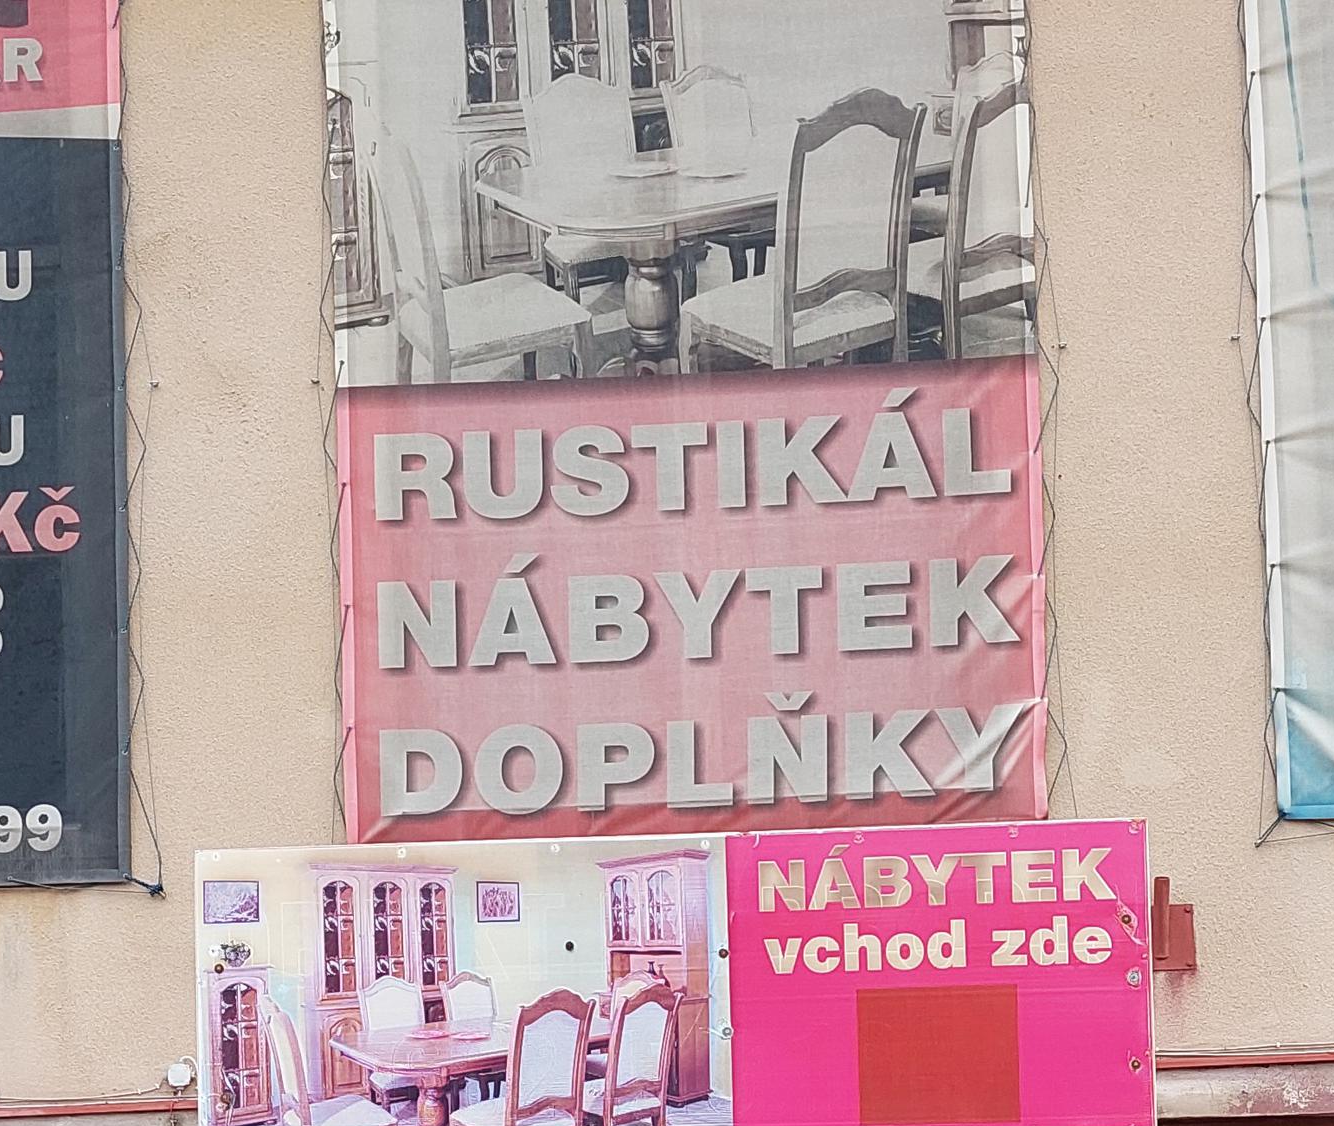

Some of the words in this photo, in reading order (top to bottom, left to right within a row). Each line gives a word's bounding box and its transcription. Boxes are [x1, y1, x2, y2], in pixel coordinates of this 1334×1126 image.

[373, 387, 1012, 522] RUSTIKÁL
[378, 554, 1021, 671] NÁBYTEK
[379, 692, 1025, 818] DOPLŇKY
[758, 845, 1117, 912] NÁBYTEK
[764, 919, 967, 974] vchod
[991, 916, 1113, 967] zde
